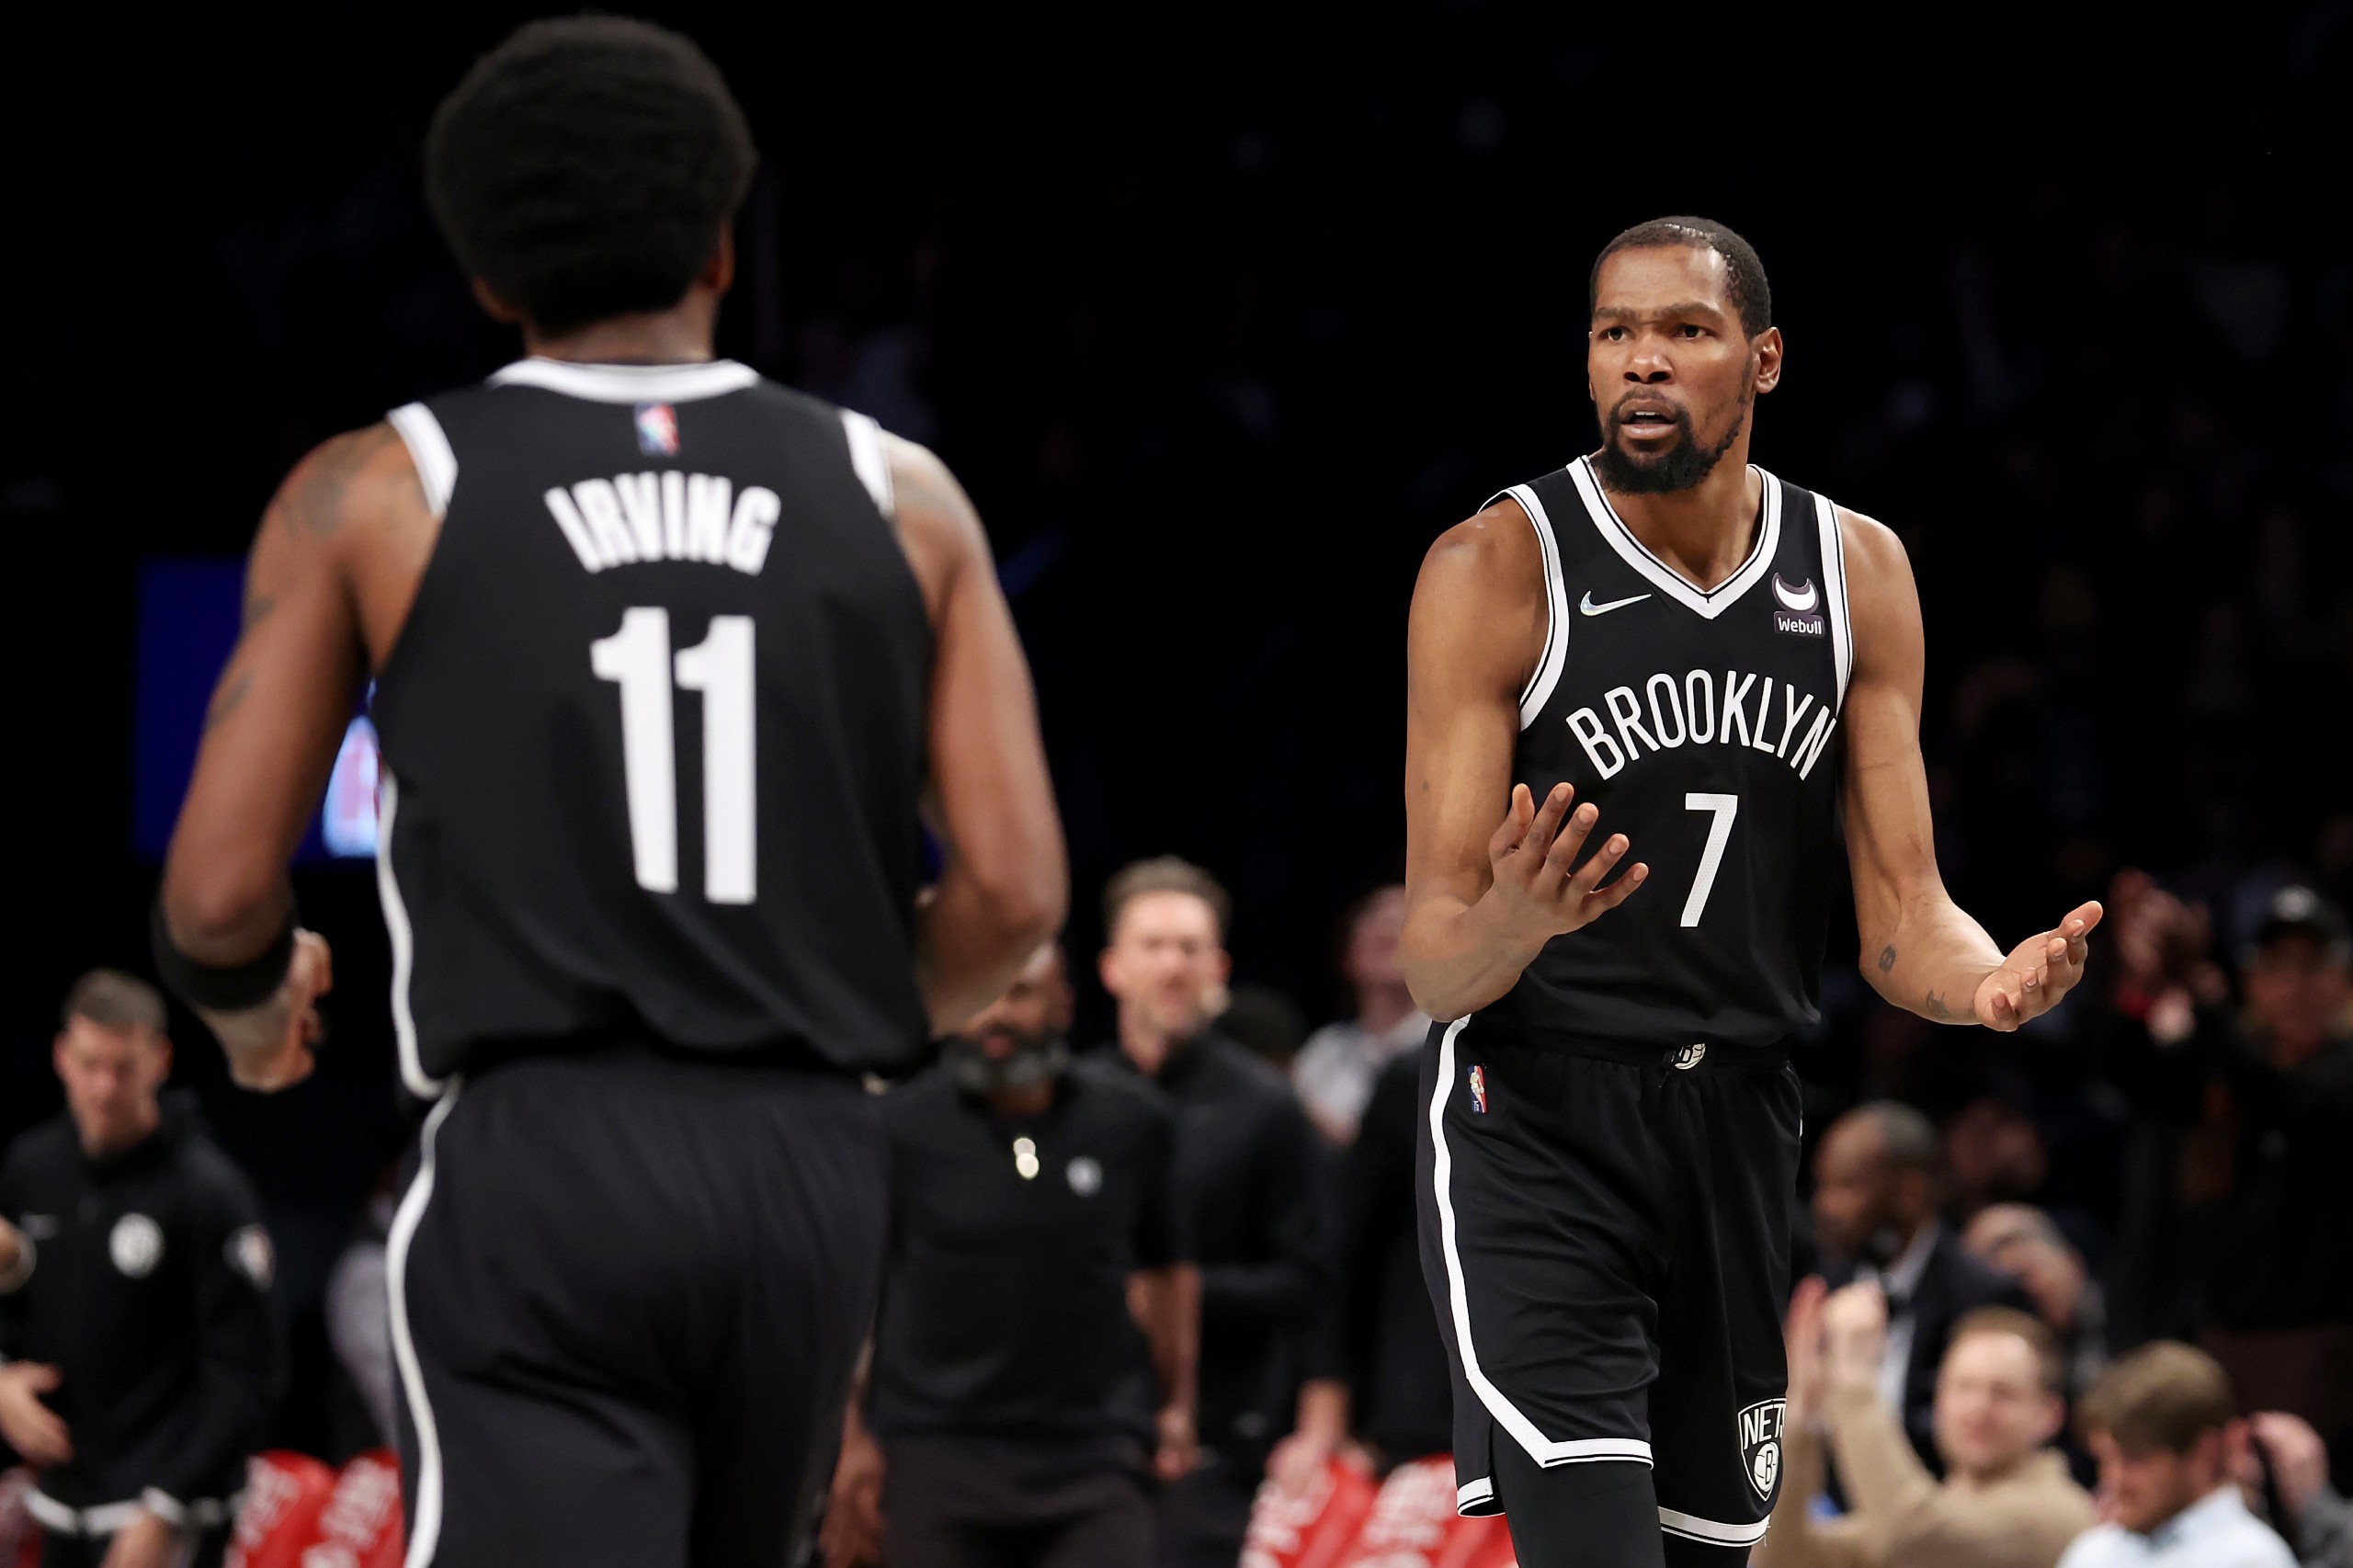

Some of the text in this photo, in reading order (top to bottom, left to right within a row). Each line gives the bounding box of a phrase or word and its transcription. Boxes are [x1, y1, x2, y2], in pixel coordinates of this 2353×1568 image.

[543, 470, 781, 576] IRVING
[1778, 617, 1822, 635] Webull
[589, 606, 758, 904] 11
[1566, 669, 1836, 780] BROOKLYN
[1680, 792, 1738, 927] 7
